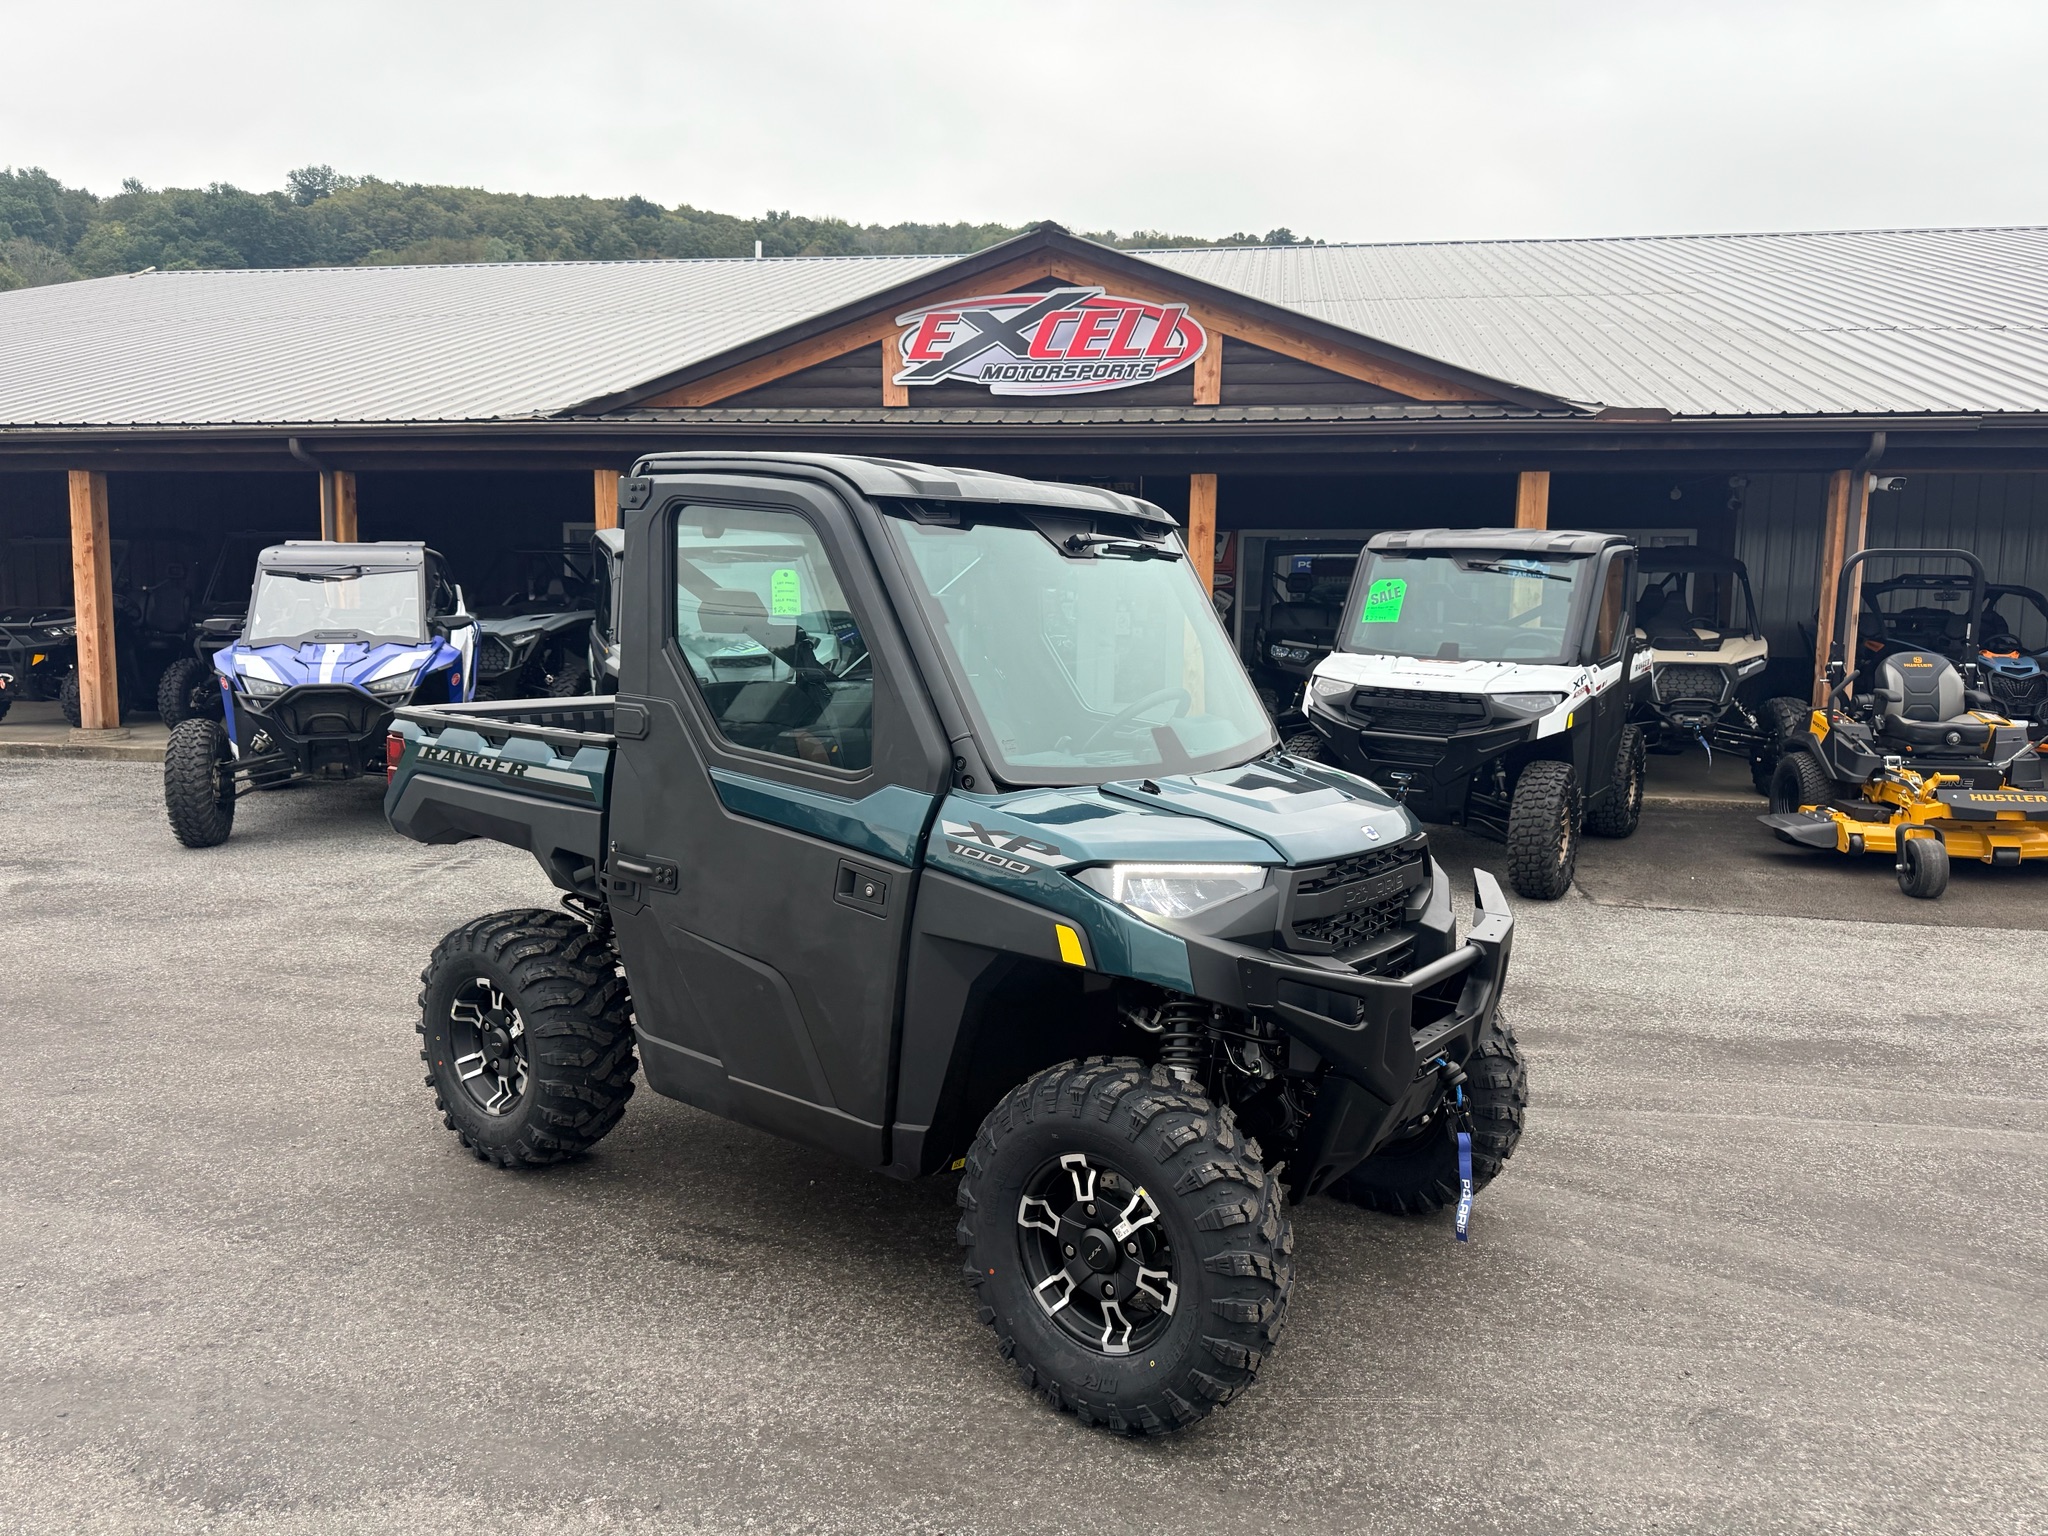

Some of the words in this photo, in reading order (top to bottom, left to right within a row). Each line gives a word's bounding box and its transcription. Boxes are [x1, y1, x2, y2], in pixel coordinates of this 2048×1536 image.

[896, 290, 1190, 382] EXCELL
[979, 361, 1158, 382] MOTORSPORTS
[1371, 586, 1402, 605] SALE
[1573, 674, 1587, 691] XP
[421, 745, 529, 777] RANGER
[1969, 792, 2048, 804] HUSTLER
[947, 820, 1062, 856] XP
[953, 844, 1032, 874] 1000
[1343, 873, 1405, 908] POLARIS
[1457, 1179, 1471, 1233] POLARIS
